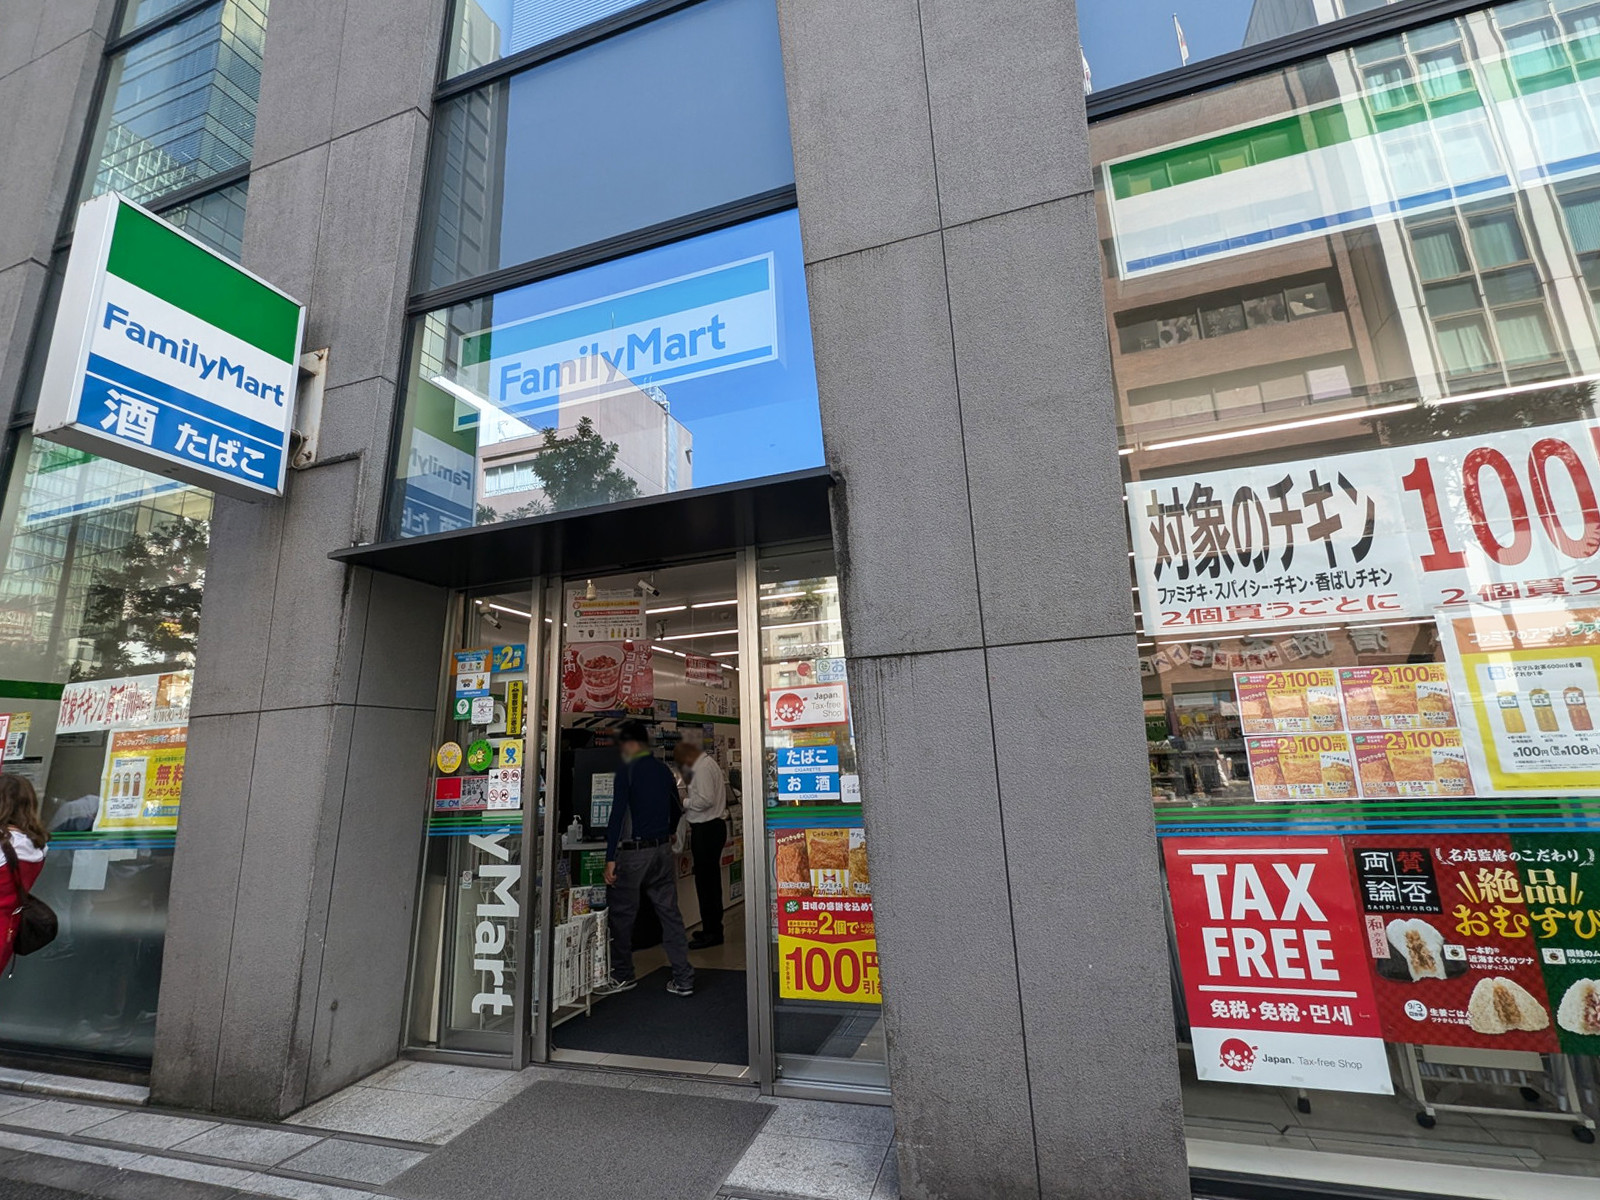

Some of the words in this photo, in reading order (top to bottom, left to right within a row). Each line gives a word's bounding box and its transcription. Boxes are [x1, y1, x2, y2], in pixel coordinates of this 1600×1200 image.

[103, 301, 284, 407] FamilyMart
[500, 314, 726, 401] FamilyMart
[100, 388, 159, 446] 酒
[174, 422, 265, 479] たばこ
[1402, 427, 1600, 572] 100
[1146, 469, 1375, 581] 対象のチキン
[1441, 575, 1600, 605] 2個買う
[1162, 594, 1400, 626] 2個買うごとに
[811, 702, 842, 710] Tax-free
[786, 749, 829, 765] たばこ
[1448, 848, 1579, 862] 名店監修のこだわり
[1191, 863, 1328, 922] TAX
[1476, 867, 1567, 904] 絶品
[468, 824, 521, 1015] yMart
[819, 912, 859, 935] 2個で
[1452, 904, 1600, 940] おむすび
[1201, 927, 1340, 981] FREE
[1298, 1056, 1336, 1068] Tax-free
[1338, 1059, 1363, 1070] Shop
